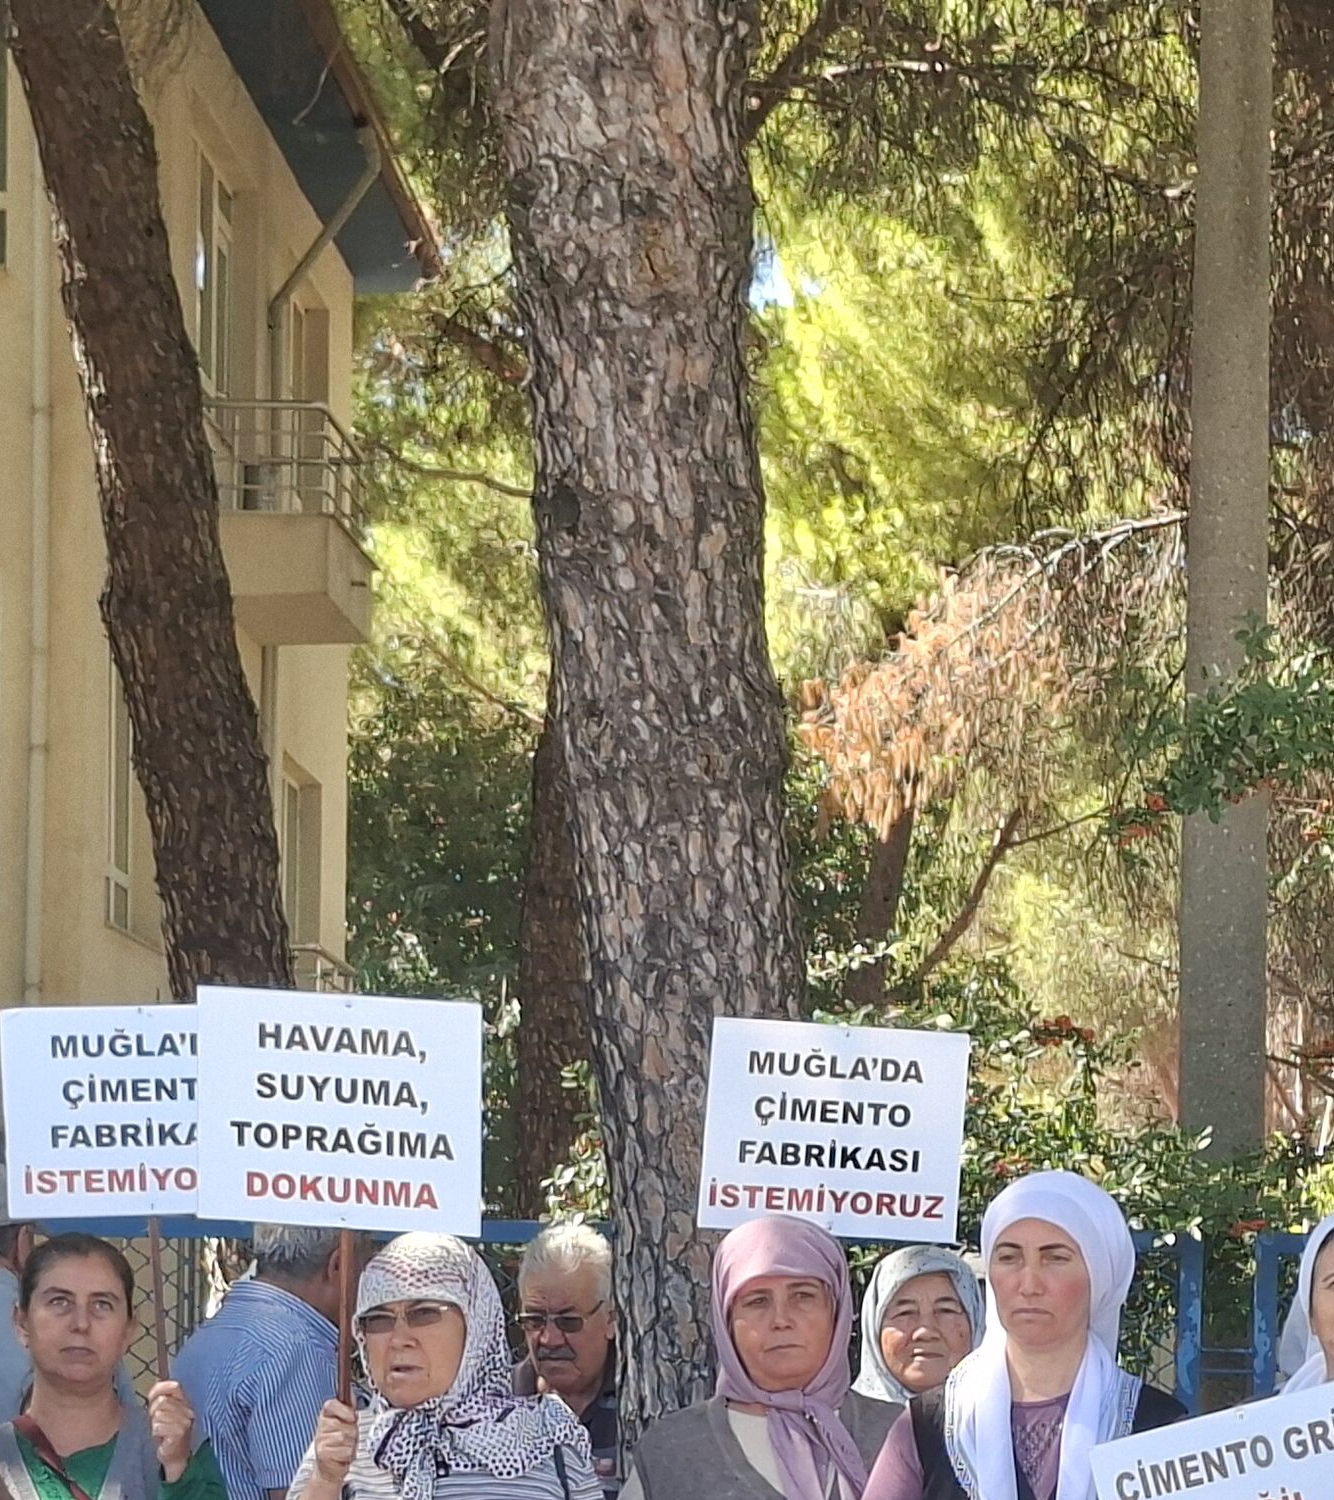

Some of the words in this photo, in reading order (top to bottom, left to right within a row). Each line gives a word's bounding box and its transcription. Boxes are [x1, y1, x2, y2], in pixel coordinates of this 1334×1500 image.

[258, 1022, 427, 1064] HAVAMA,
[748, 1048, 924, 1083] MUĞLA'DA
[62, 1074, 197, 1109] ÇİMENT
[255, 1072, 428, 1115] SUYUMA,
[755, 1091, 911, 1126] ÇİMENTO
[229, 1120, 454, 1160] TOPRAĞIMA
[738, 1139, 920, 1173] FABRİKASI
[25, 1163, 197, 1194] İSTEMİYO
[246, 1171, 439, 1209] DOKUNMA
[709, 1177, 944, 1218] İSTEMİYORUZ
